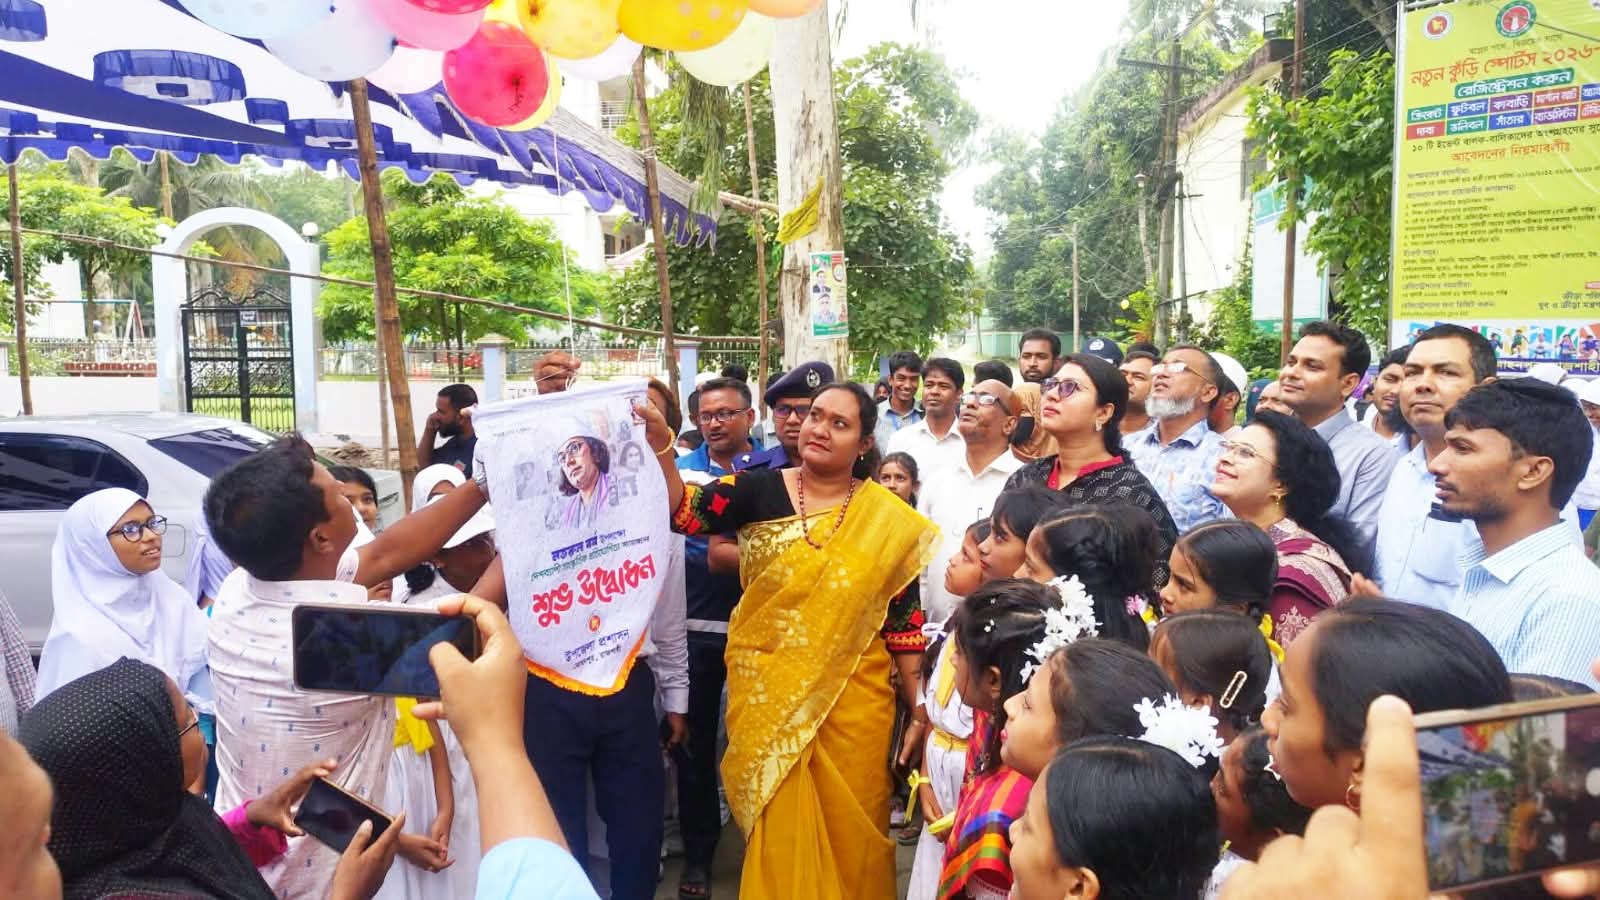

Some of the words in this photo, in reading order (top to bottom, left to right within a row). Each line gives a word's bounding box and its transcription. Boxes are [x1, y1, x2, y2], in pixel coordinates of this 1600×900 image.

[1411, 67, 1444, 87] নতুন
[1449, 57, 1479, 83] কুঁড়ি
[532, 582, 574, 628] শুভ
[577, 553, 656, 605] উদ্বোধন
[599, 629, 629, 646] প্রশাসন
